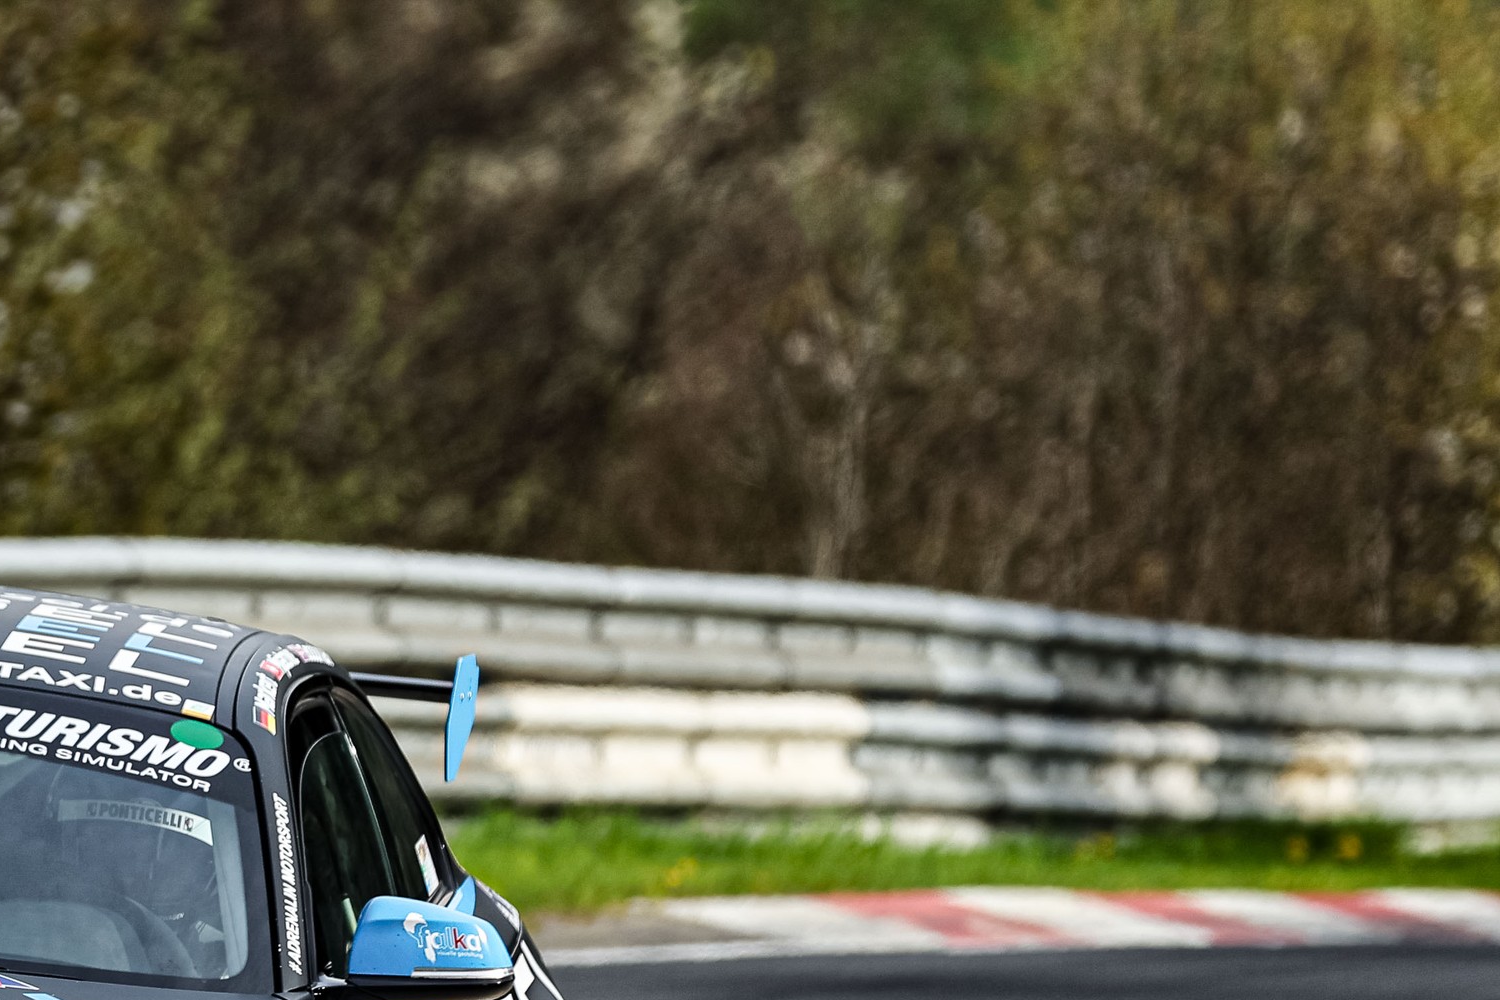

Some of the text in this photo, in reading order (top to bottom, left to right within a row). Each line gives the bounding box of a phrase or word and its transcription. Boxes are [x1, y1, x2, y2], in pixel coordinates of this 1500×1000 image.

[54, 748, 212, 793] SIMULATOR
[101, 802, 183, 829] PONTICELLI
[272, 792, 296, 886] MOTORSPORT
